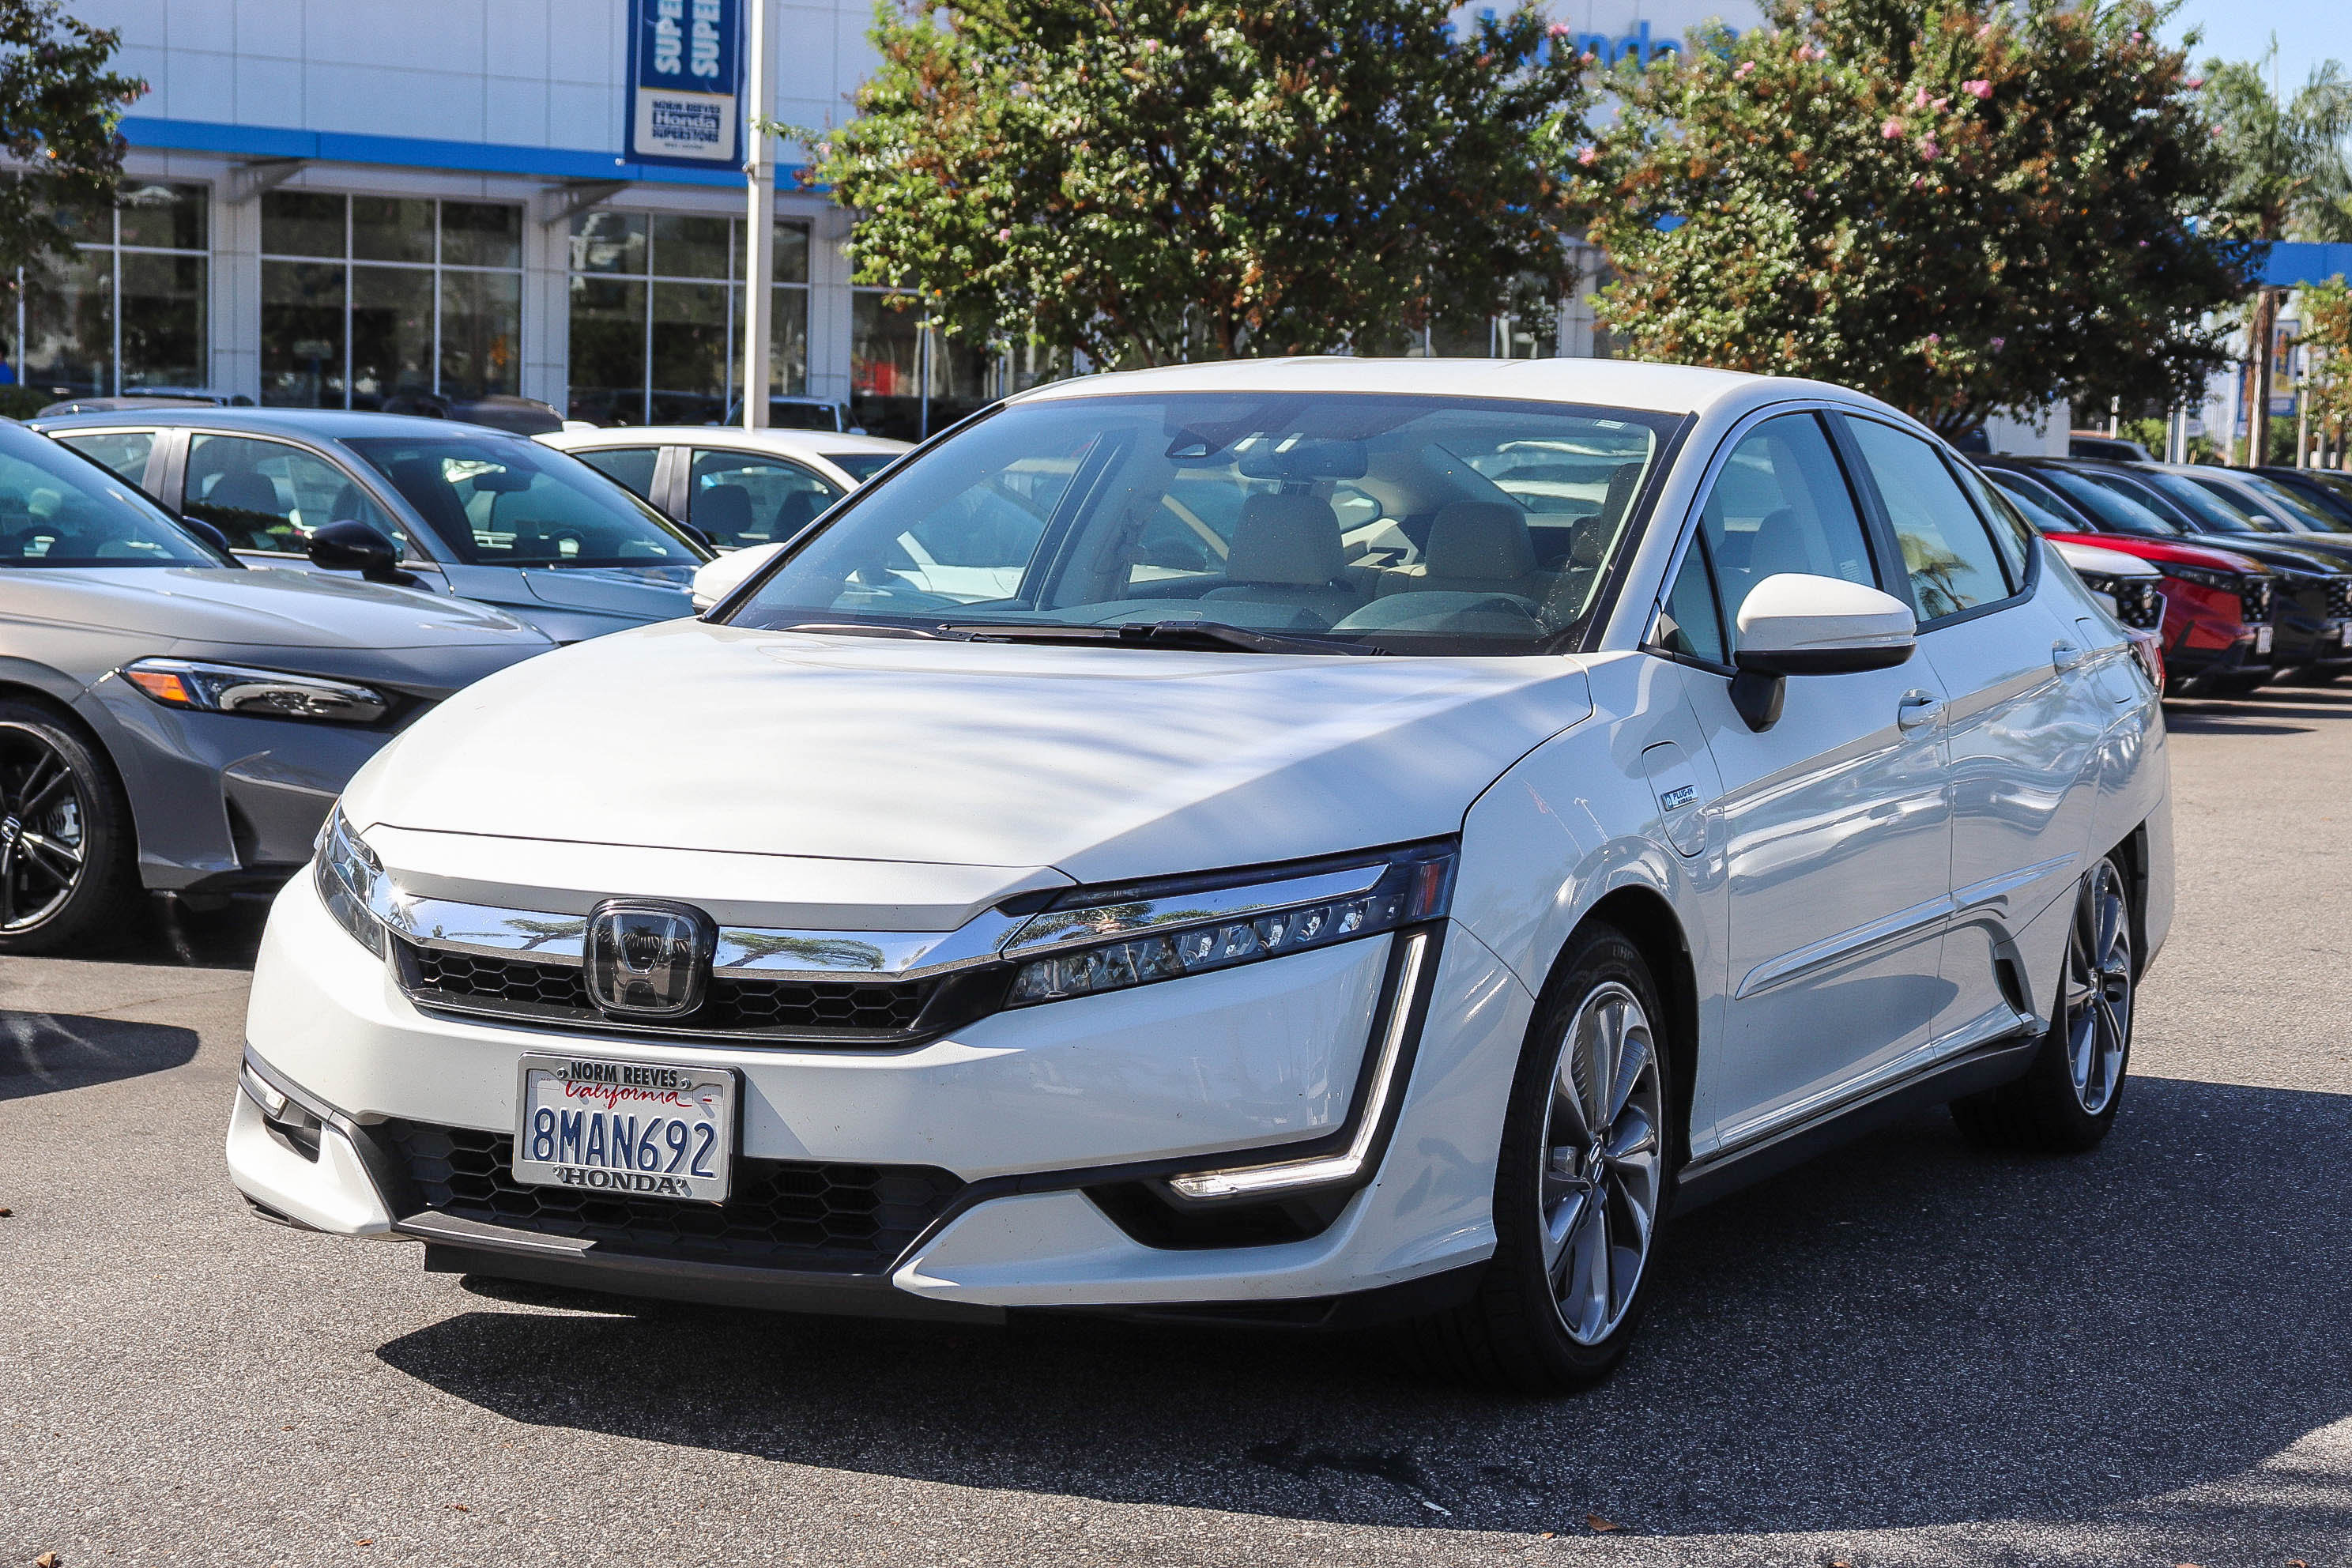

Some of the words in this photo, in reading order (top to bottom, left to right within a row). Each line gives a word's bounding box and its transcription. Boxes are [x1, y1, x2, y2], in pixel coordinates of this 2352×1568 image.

[691, 0, 721, 77] SUPE
[654, 111, 718, 129] Honda
[570, 1061, 618, 1083] NORM
[623, 1065, 678, 1088] REEVES
[565, 1080, 693, 1110] California
[532, 1108, 716, 1178] 8MAN692
[563, 1167, 681, 1196] HONDA
